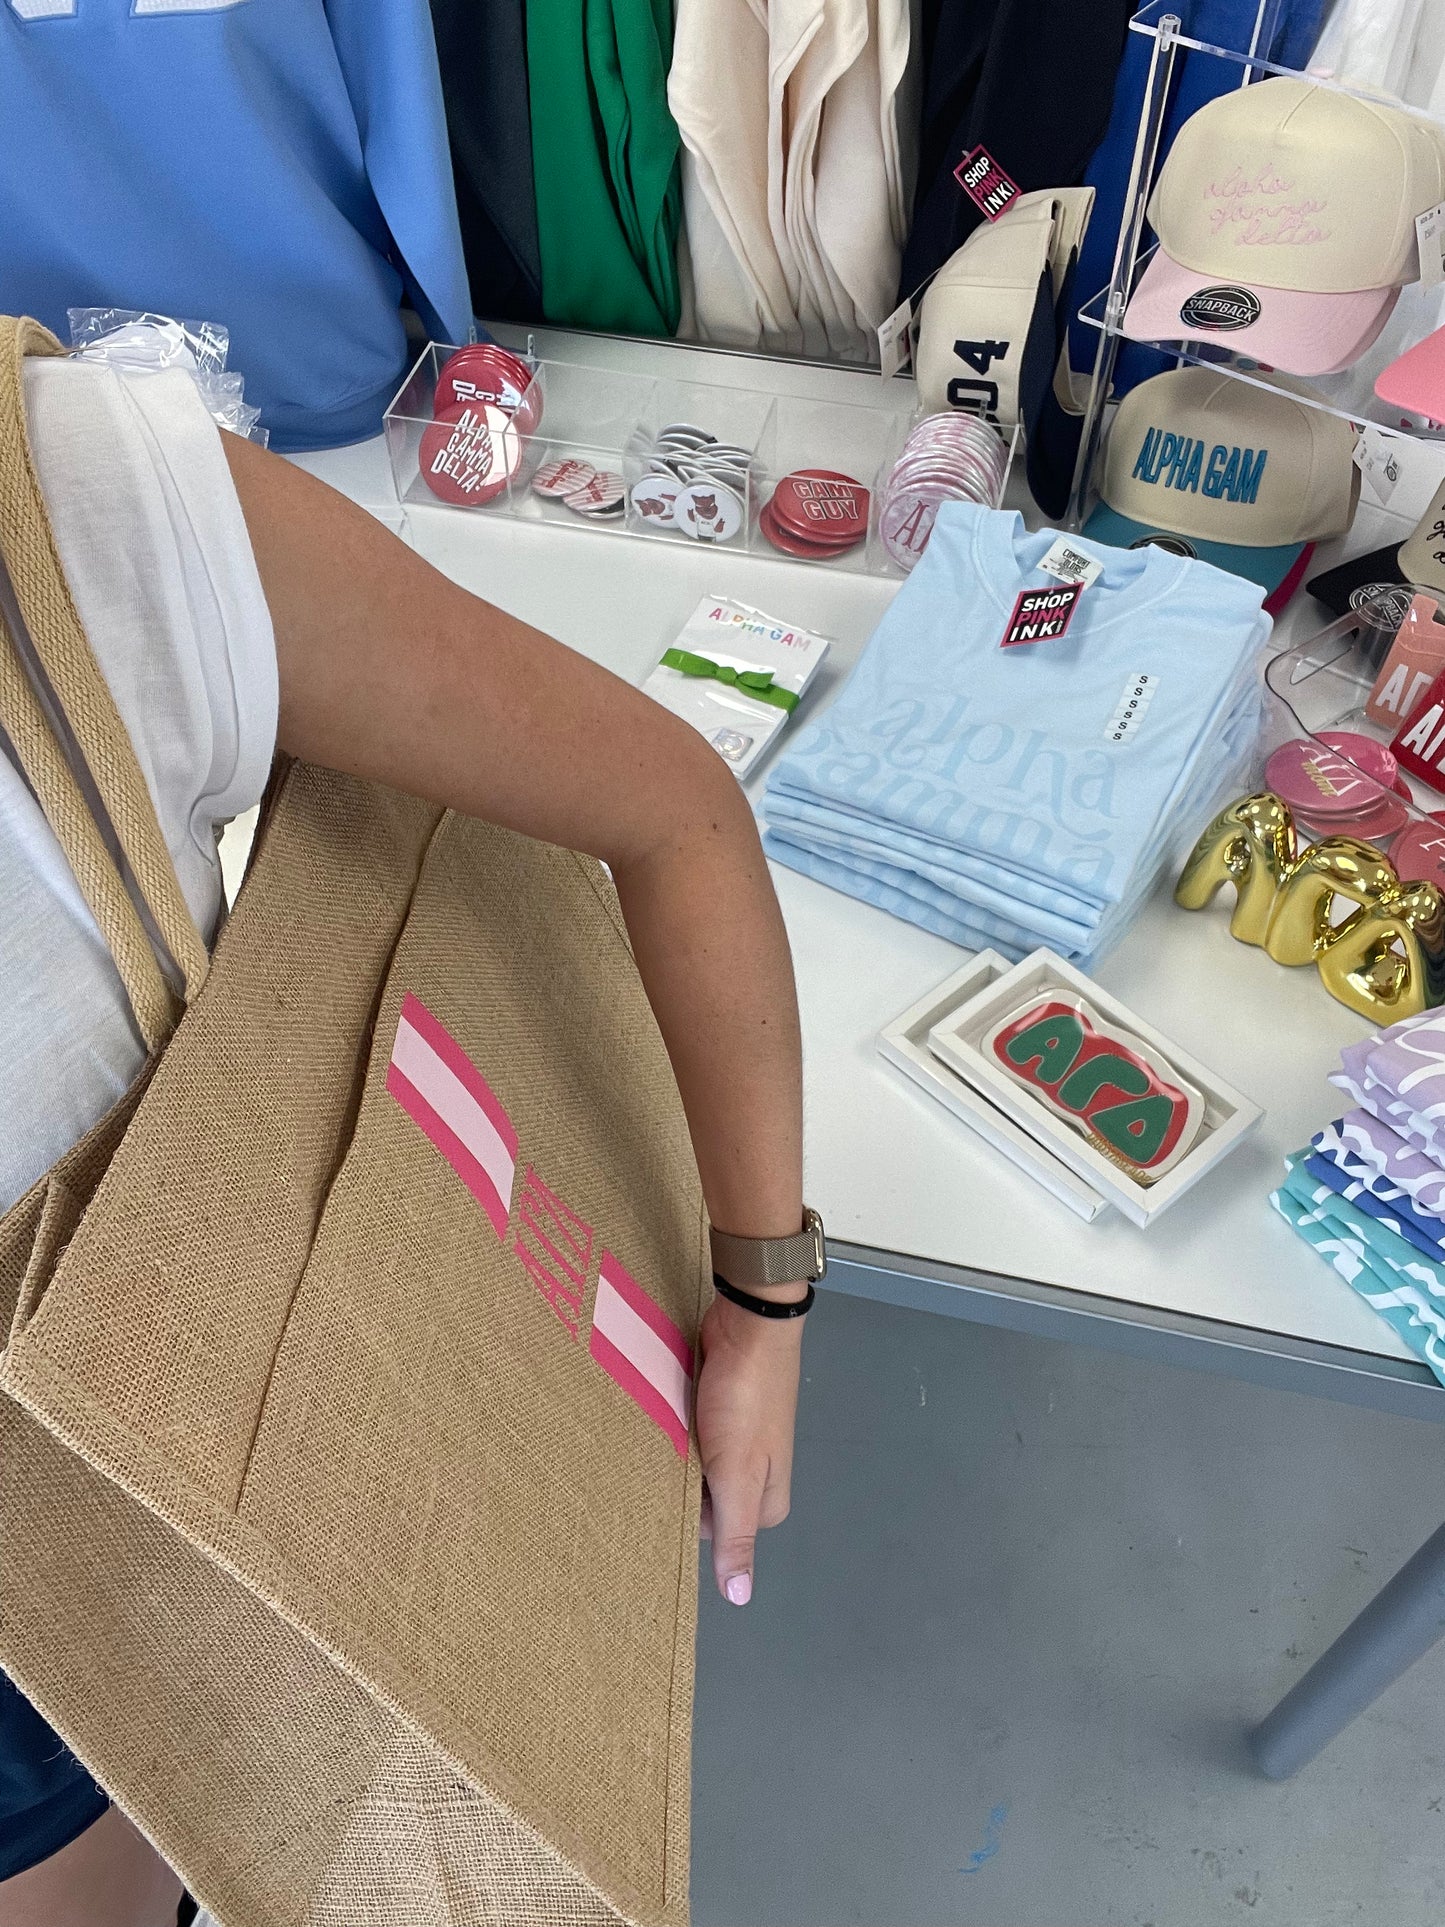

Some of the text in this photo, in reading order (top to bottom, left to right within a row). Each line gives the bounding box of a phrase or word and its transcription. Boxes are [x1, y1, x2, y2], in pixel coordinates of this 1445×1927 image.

[964, 156, 990, 188] SHOP
[973, 168, 1004, 202] PINK
[1186, 299, 1257, 322] SNAPBACK
[446, 432, 493, 475] GAMMA
[1131, 426, 1268, 505] ALPHA GAM
[792, 479, 853, 499] GAM
[802, 499, 859, 521] GUY
[1021, 592, 1075, 612] SHOP
[1016, 605, 1069, 627] PINK
[769, 628, 812, 652] GAM
[1139, 675, 1149, 684] S
[1133, 687, 1144, 697] S
[1123, 711, 1133, 719] S
[1128, 699, 1138, 709] S
[1112, 732, 1123, 741] S
[1118, 721, 1128, 730] S
[871, 695, 1123, 842] alpha
